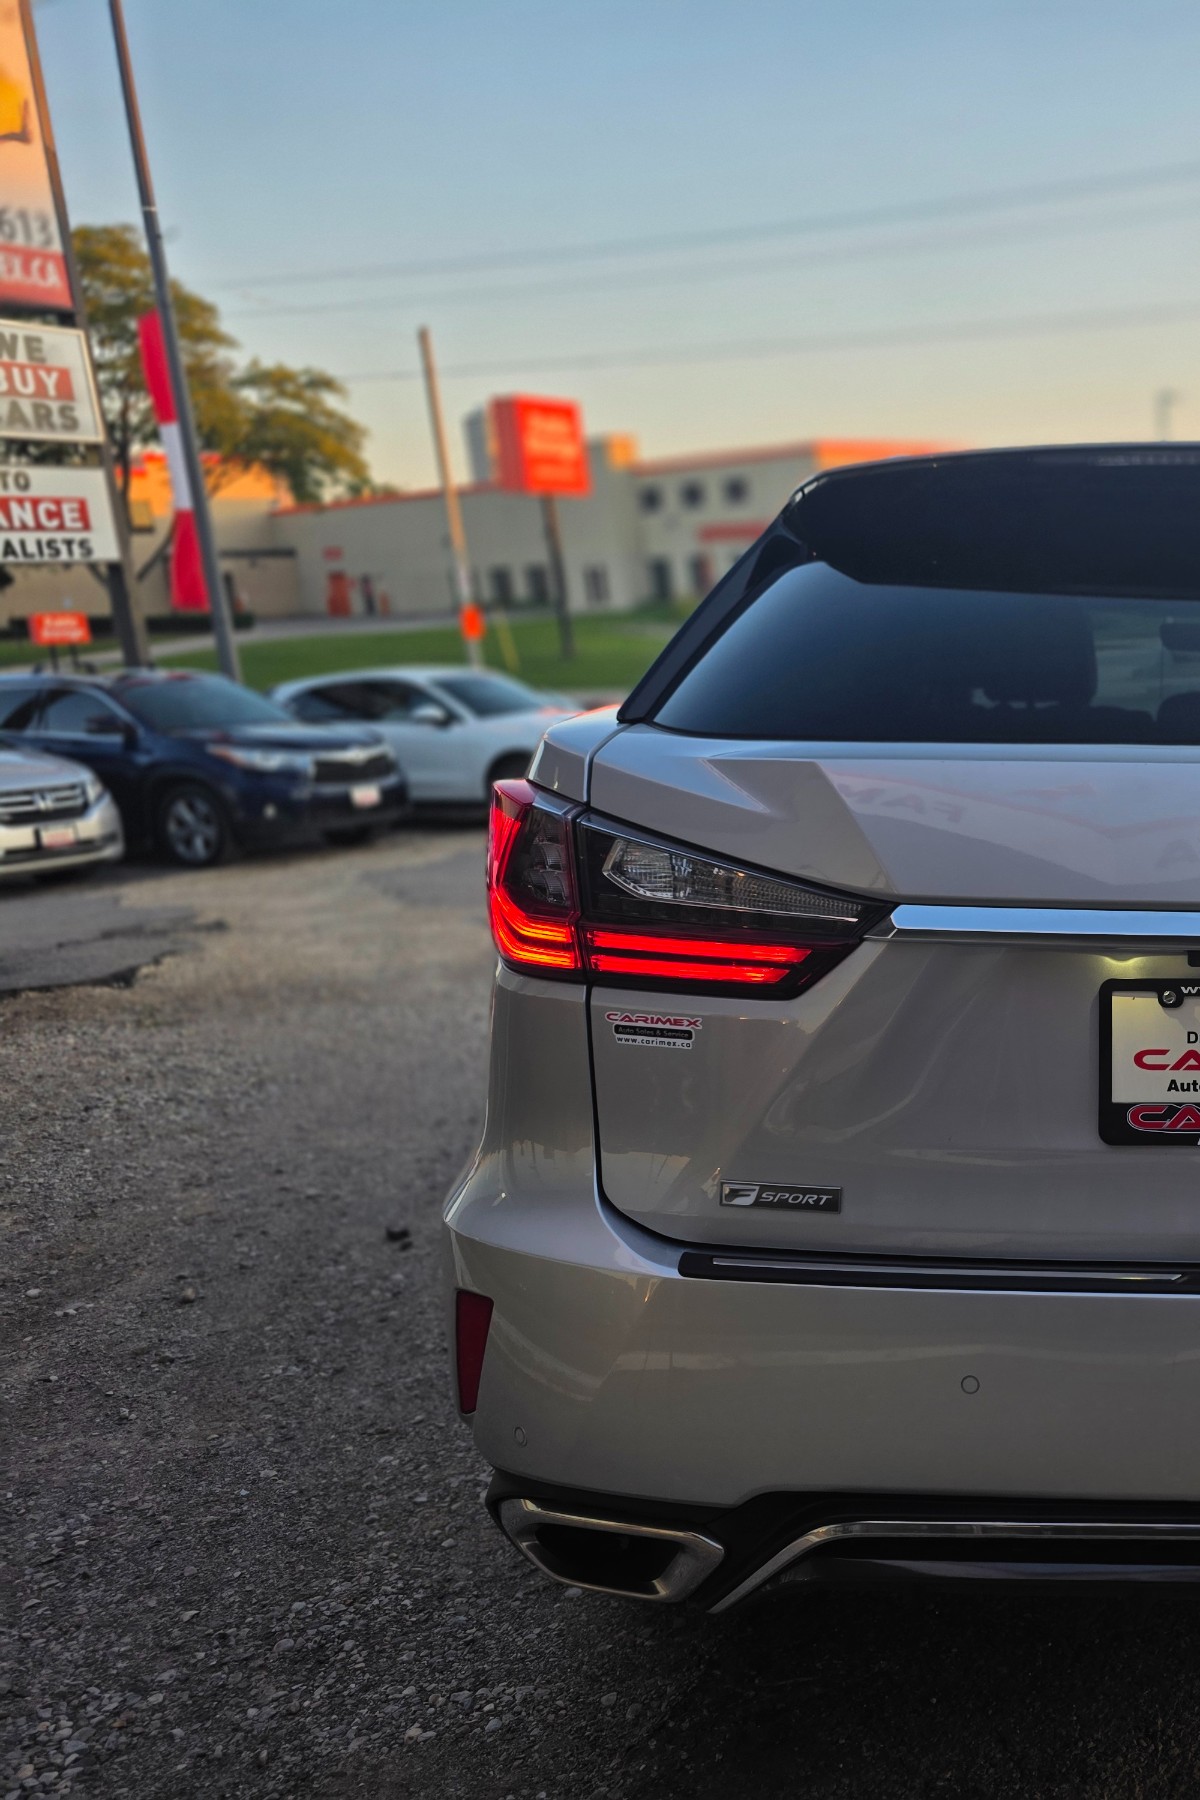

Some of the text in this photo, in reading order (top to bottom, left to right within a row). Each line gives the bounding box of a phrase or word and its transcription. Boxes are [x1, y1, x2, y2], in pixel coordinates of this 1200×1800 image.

[0, 399, 79, 433] ARS
[606, 1013, 702, 1028] CARIMEX
[617, 1036, 691, 1048] www.carimex.ca
[760, 1191, 833, 1205] SPORT
